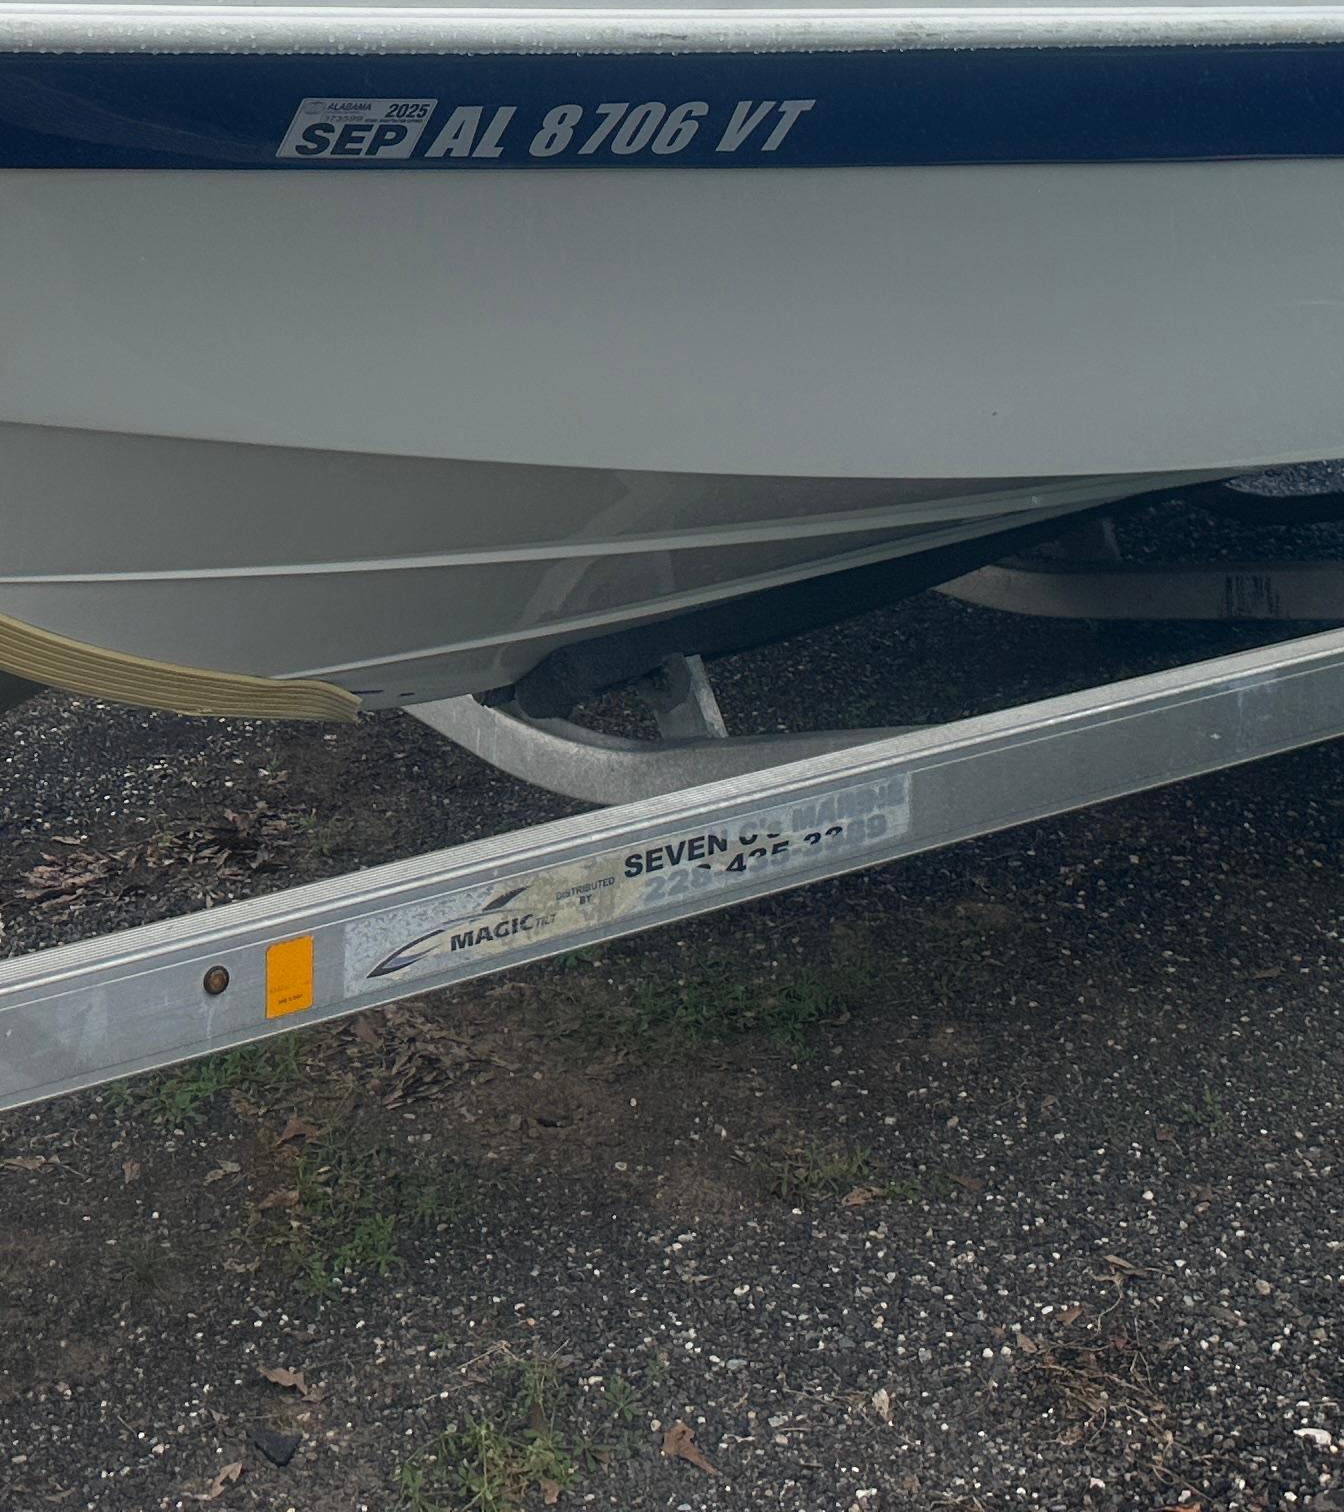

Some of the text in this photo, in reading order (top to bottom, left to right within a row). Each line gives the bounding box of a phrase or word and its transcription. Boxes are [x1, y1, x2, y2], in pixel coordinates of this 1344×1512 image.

[327, 103, 372, 111] ALABAMA
[384, 103, 431, 119] 2025
[295, 122, 409, 157] SEP
[424, 99, 817, 158] AL 8706 VT
[624, 828, 728, 878] SEVEN
[556, 876, 616, 901] DISTRIBUTED
[579, 893, 593, 905] BY
[450, 913, 534, 952] MAGIC
